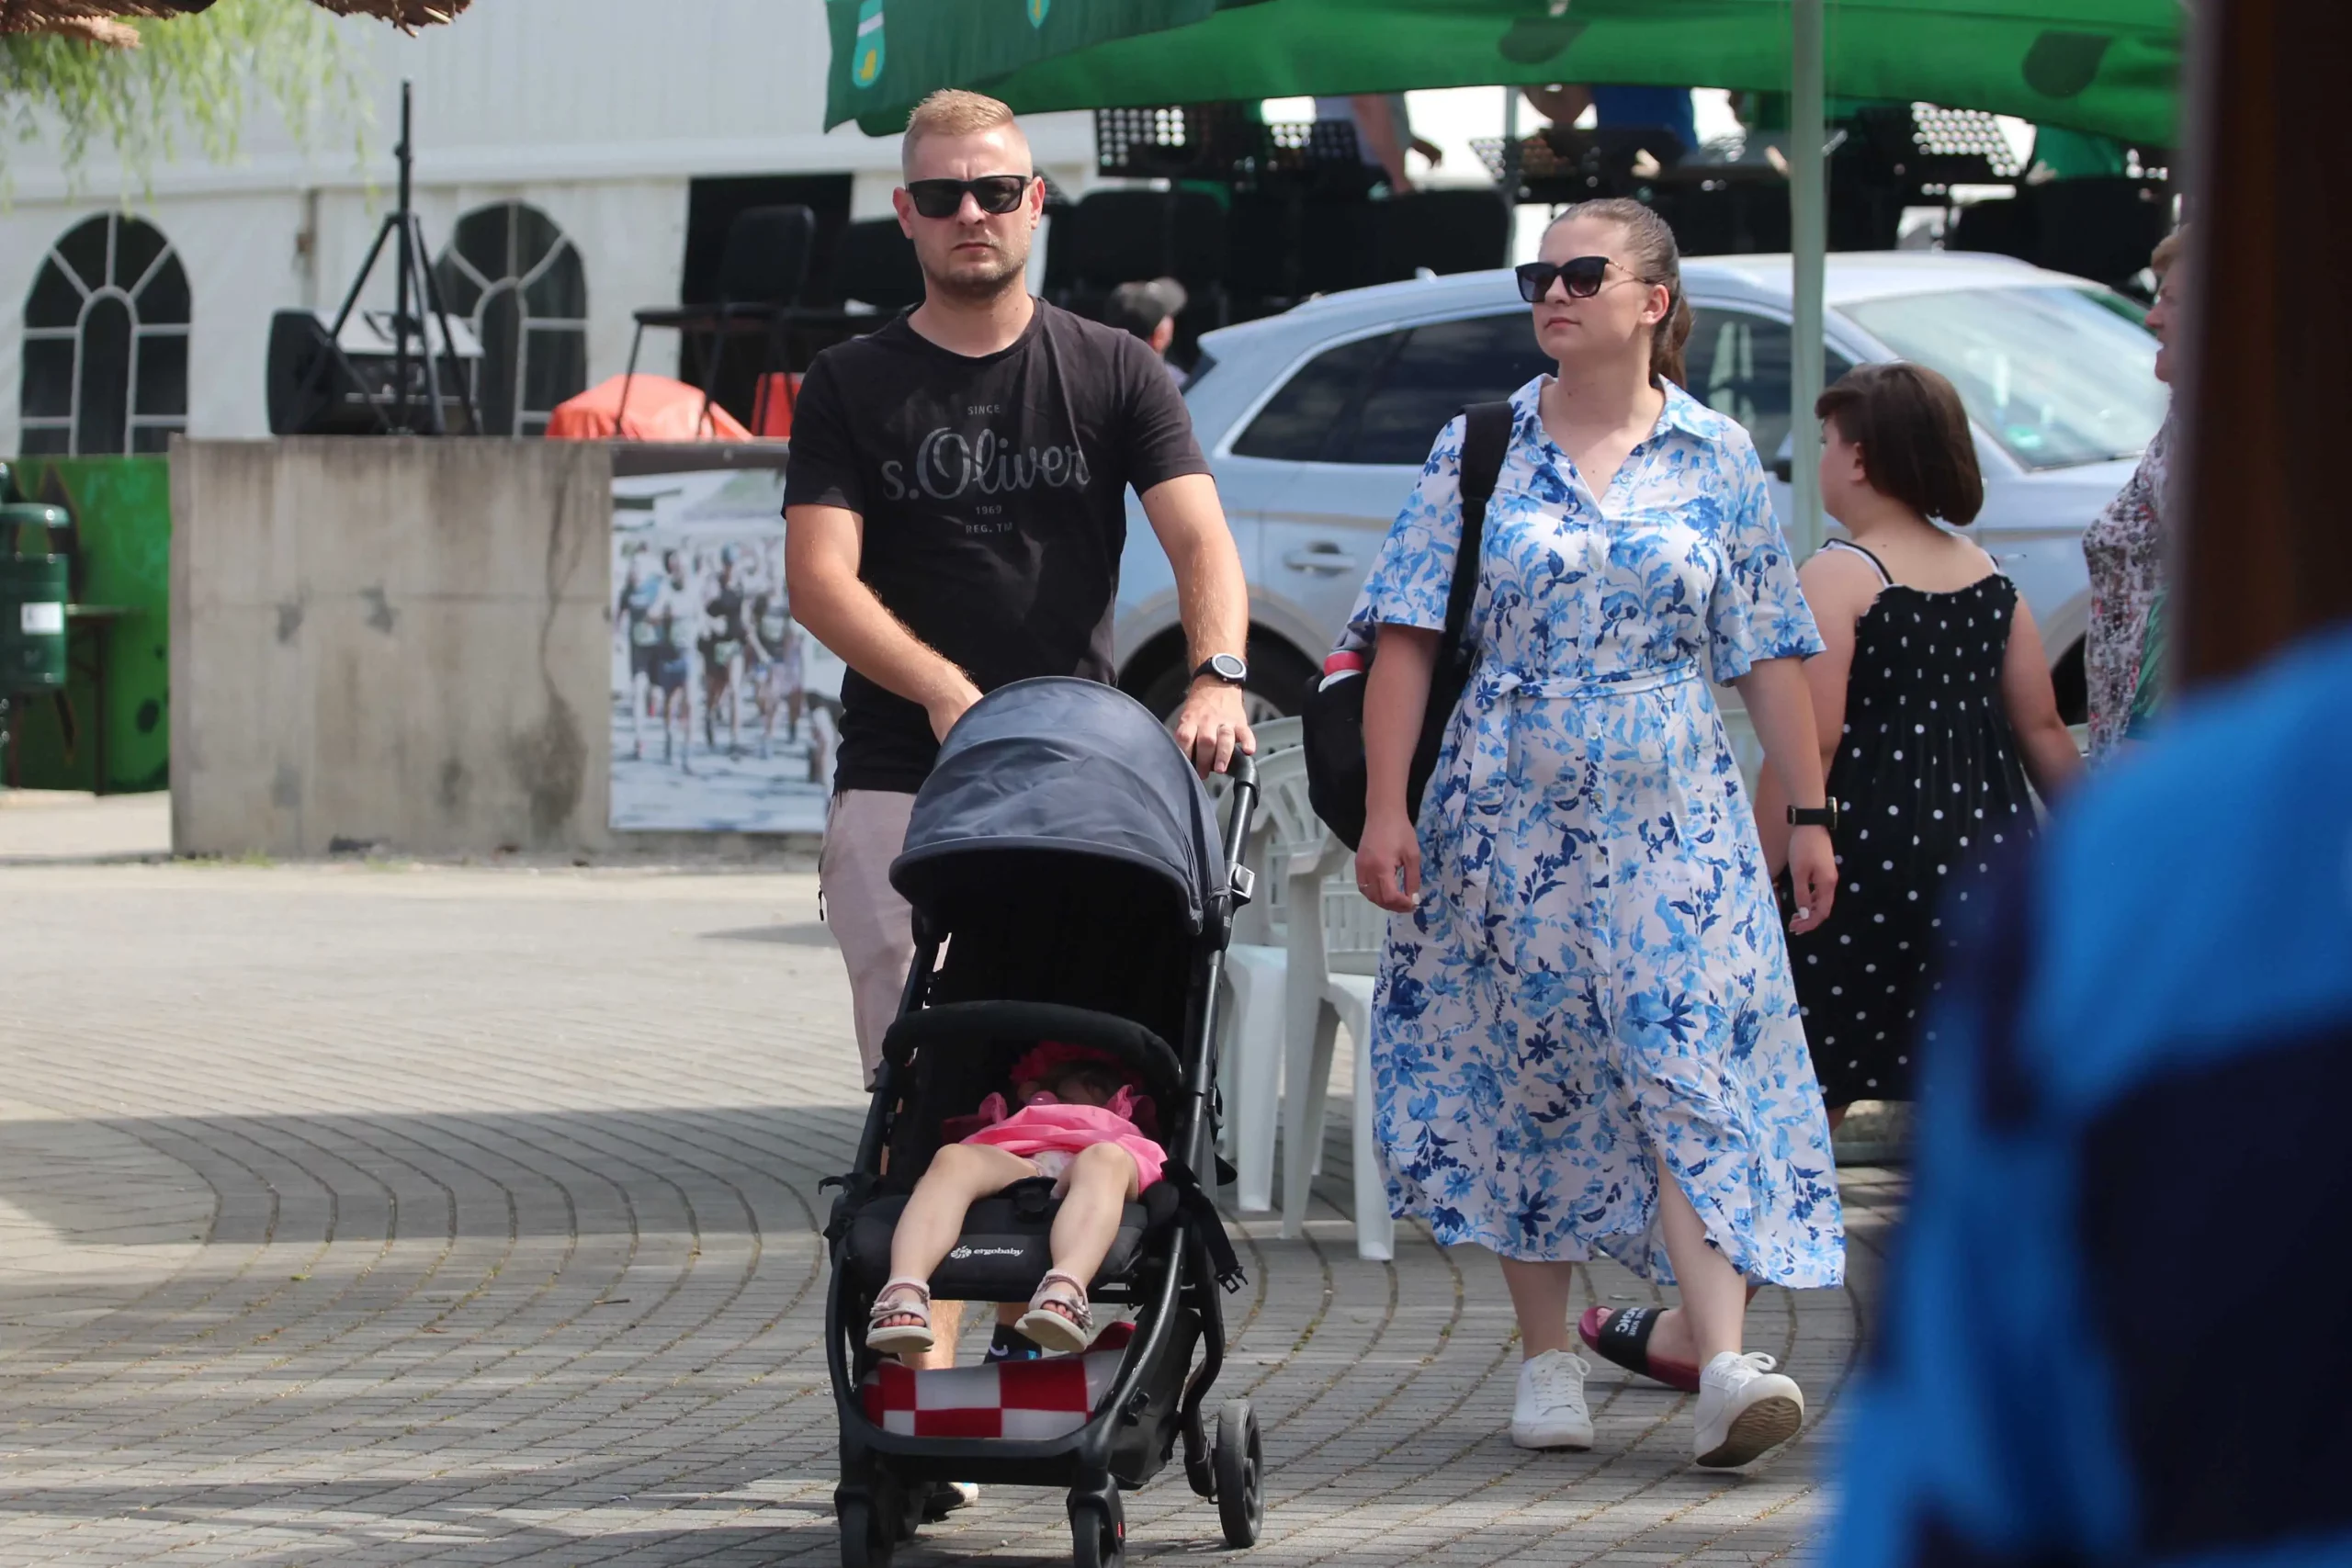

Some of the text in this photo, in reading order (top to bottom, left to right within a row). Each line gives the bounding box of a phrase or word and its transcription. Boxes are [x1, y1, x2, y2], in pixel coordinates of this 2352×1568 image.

[967, 404, 1001, 415] SINCE
[880, 426, 1091, 501] s.Oliver
[975, 504, 1002, 515] 1969
[965, 521, 1013, 535] REG. TM
[973, 1247, 1024, 1257] ergobaby
